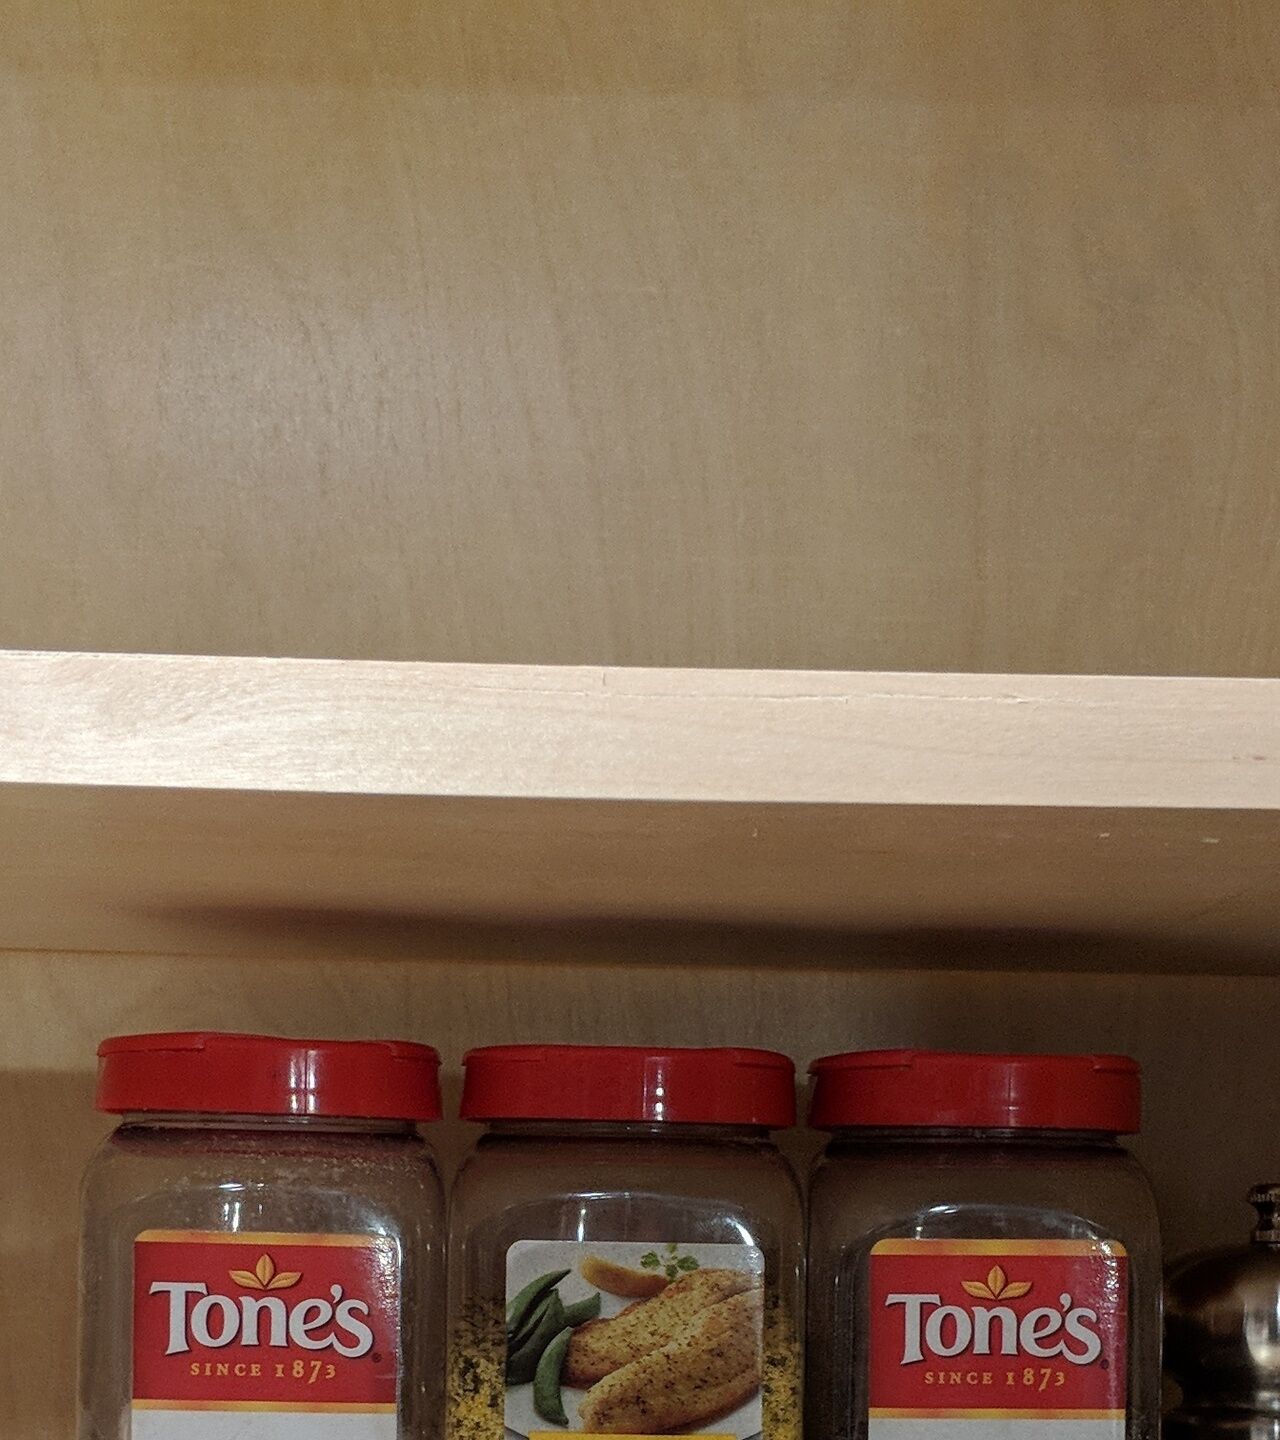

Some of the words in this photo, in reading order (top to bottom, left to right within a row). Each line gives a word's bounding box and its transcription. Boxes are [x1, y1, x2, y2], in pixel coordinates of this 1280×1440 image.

[149, 1281, 373, 1358] Tone's
[884, 1292, 1104, 1366] Tone's
[190, 1363, 262, 1377] SINCE
[275, 1359, 338, 1384] 1873
[924, 1371, 994, 1386] SINCE
[1006, 1368, 1066, 1392] 1873
